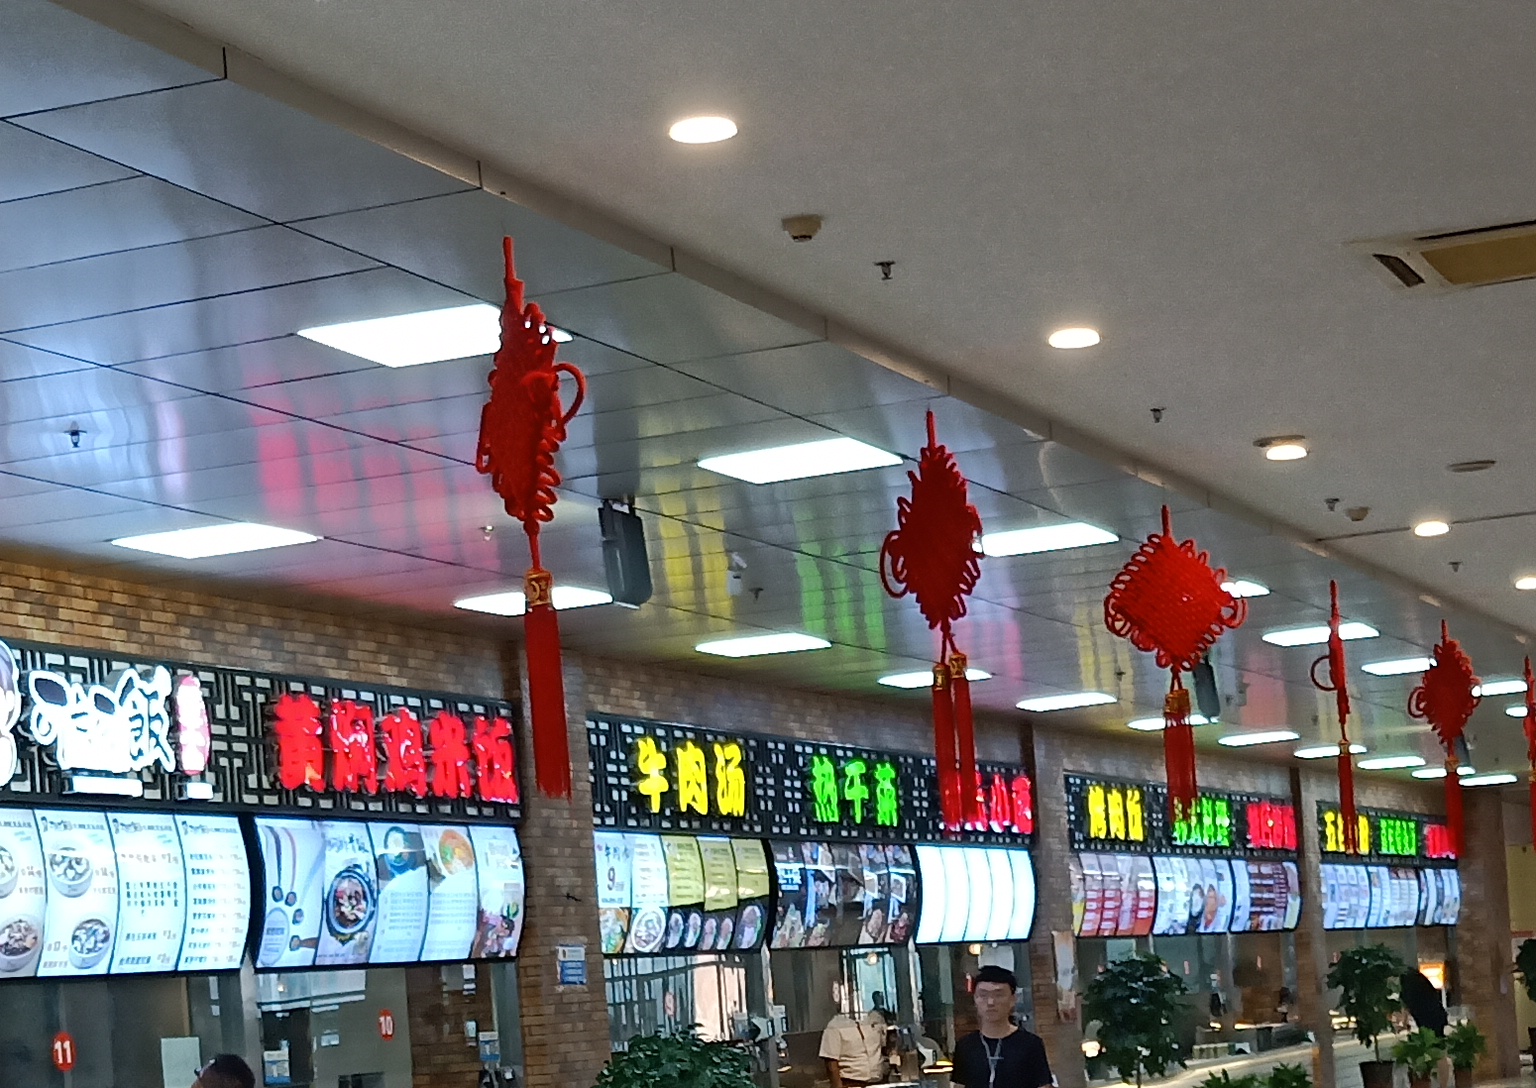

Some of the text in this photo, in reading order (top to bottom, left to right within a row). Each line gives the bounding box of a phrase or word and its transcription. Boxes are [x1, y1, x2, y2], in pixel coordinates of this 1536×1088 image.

[275, 693, 520, 804] 黄焖鸡米饭
[637, 736, 746, 817] 牛肉汤
[378, 1014, 394, 1035] 10
[53, 1040, 72, 1064] 11
